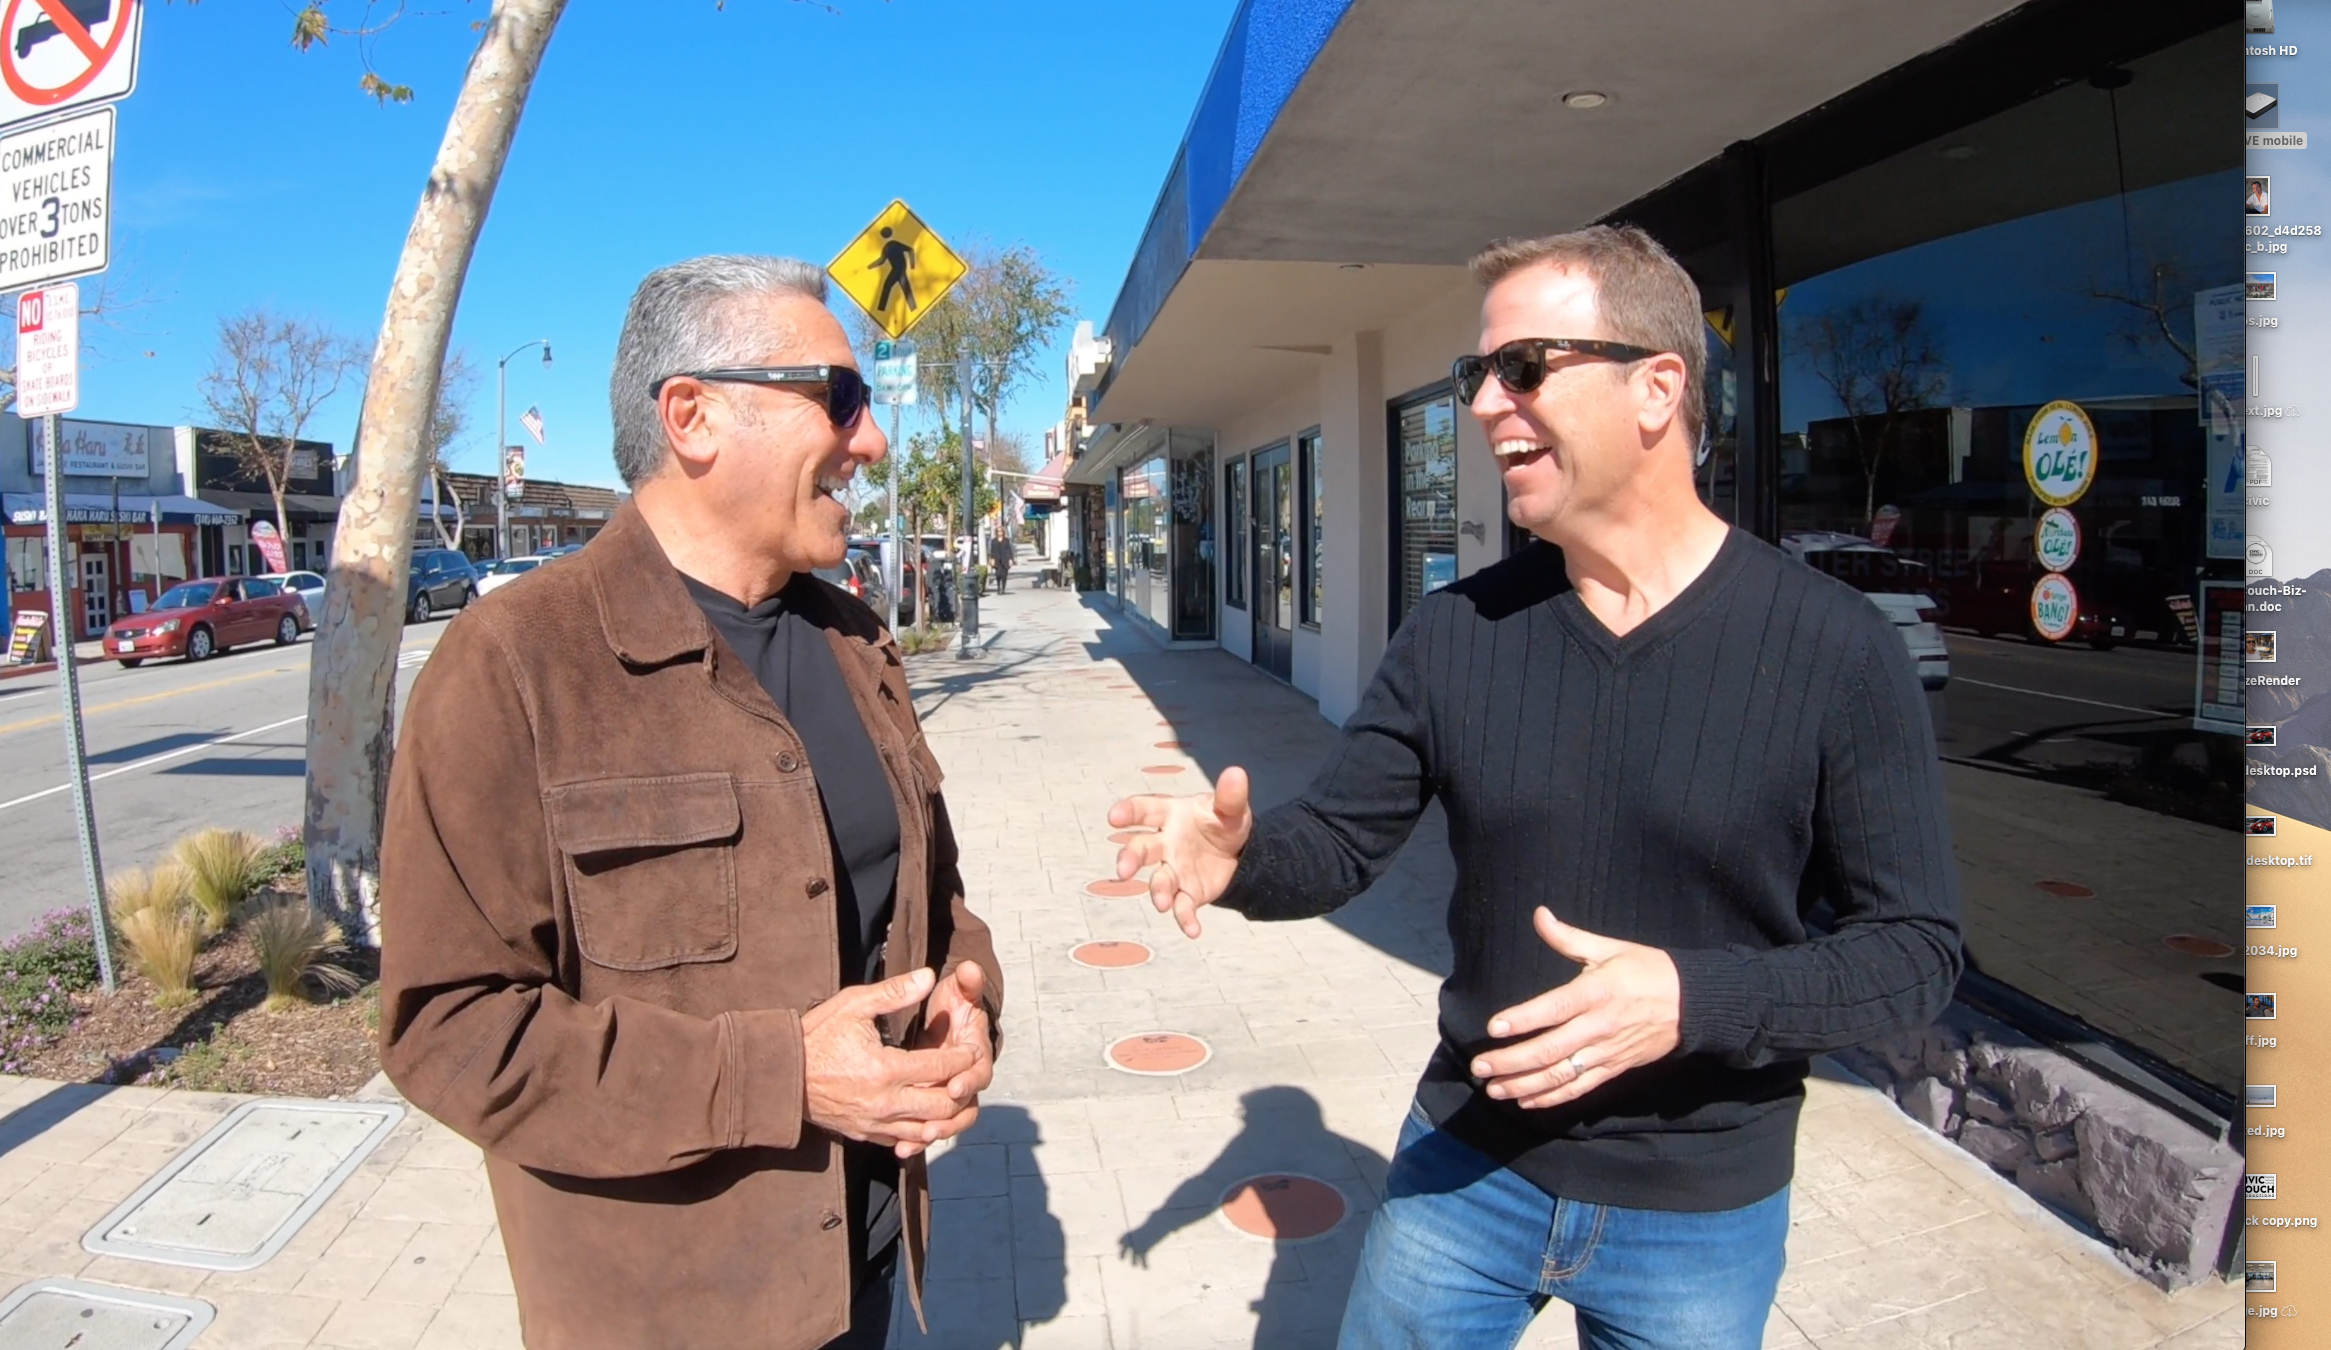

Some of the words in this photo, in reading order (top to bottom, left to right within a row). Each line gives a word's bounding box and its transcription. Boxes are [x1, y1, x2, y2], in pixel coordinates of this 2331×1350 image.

[2279, 46, 2298, 56] HD
[2263, 135, 2303, 146] mobile
[2, 129, 104, 173] COMMERCIAL
[12, 166, 91, 202] VEHICLES
[0, 212, 38, 240] OVER
[40, 197, 61, 239] 3
[61, 197, 102, 226] TONS
[0, 233, 99, 273] PROHIBITED
[21, 298, 41, 328] NO
[33, 330, 62, 345] RIDING
[27, 344, 69, 363] BICYCLES
[877, 344, 888, 359] 2
[42, 362, 53, 374] OR
[46, 373, 73, 389] BOARDS
[37, 389, 71, 406] SIDEWALK
[70, 461, 108, 469] RESTAURANT
[2036, 449, 2088, 481] OLÉ!
[1405, 497, 1426, 518] Rear
[13, 510, 36, 522] SUSHI
[110, 511, 130, 522] SSHI
[132, 511, 146, 522] BAR
[2246, 585, 2306, 596] ouch-Biz-
[2246, 601, 2281, 612] n.doc
[2246, 855, 2312, 867] desktop.tif
[2262, 1215, 2317, 1228] copy.png
[2246, 1305, 2277, 1318] e.jpg
